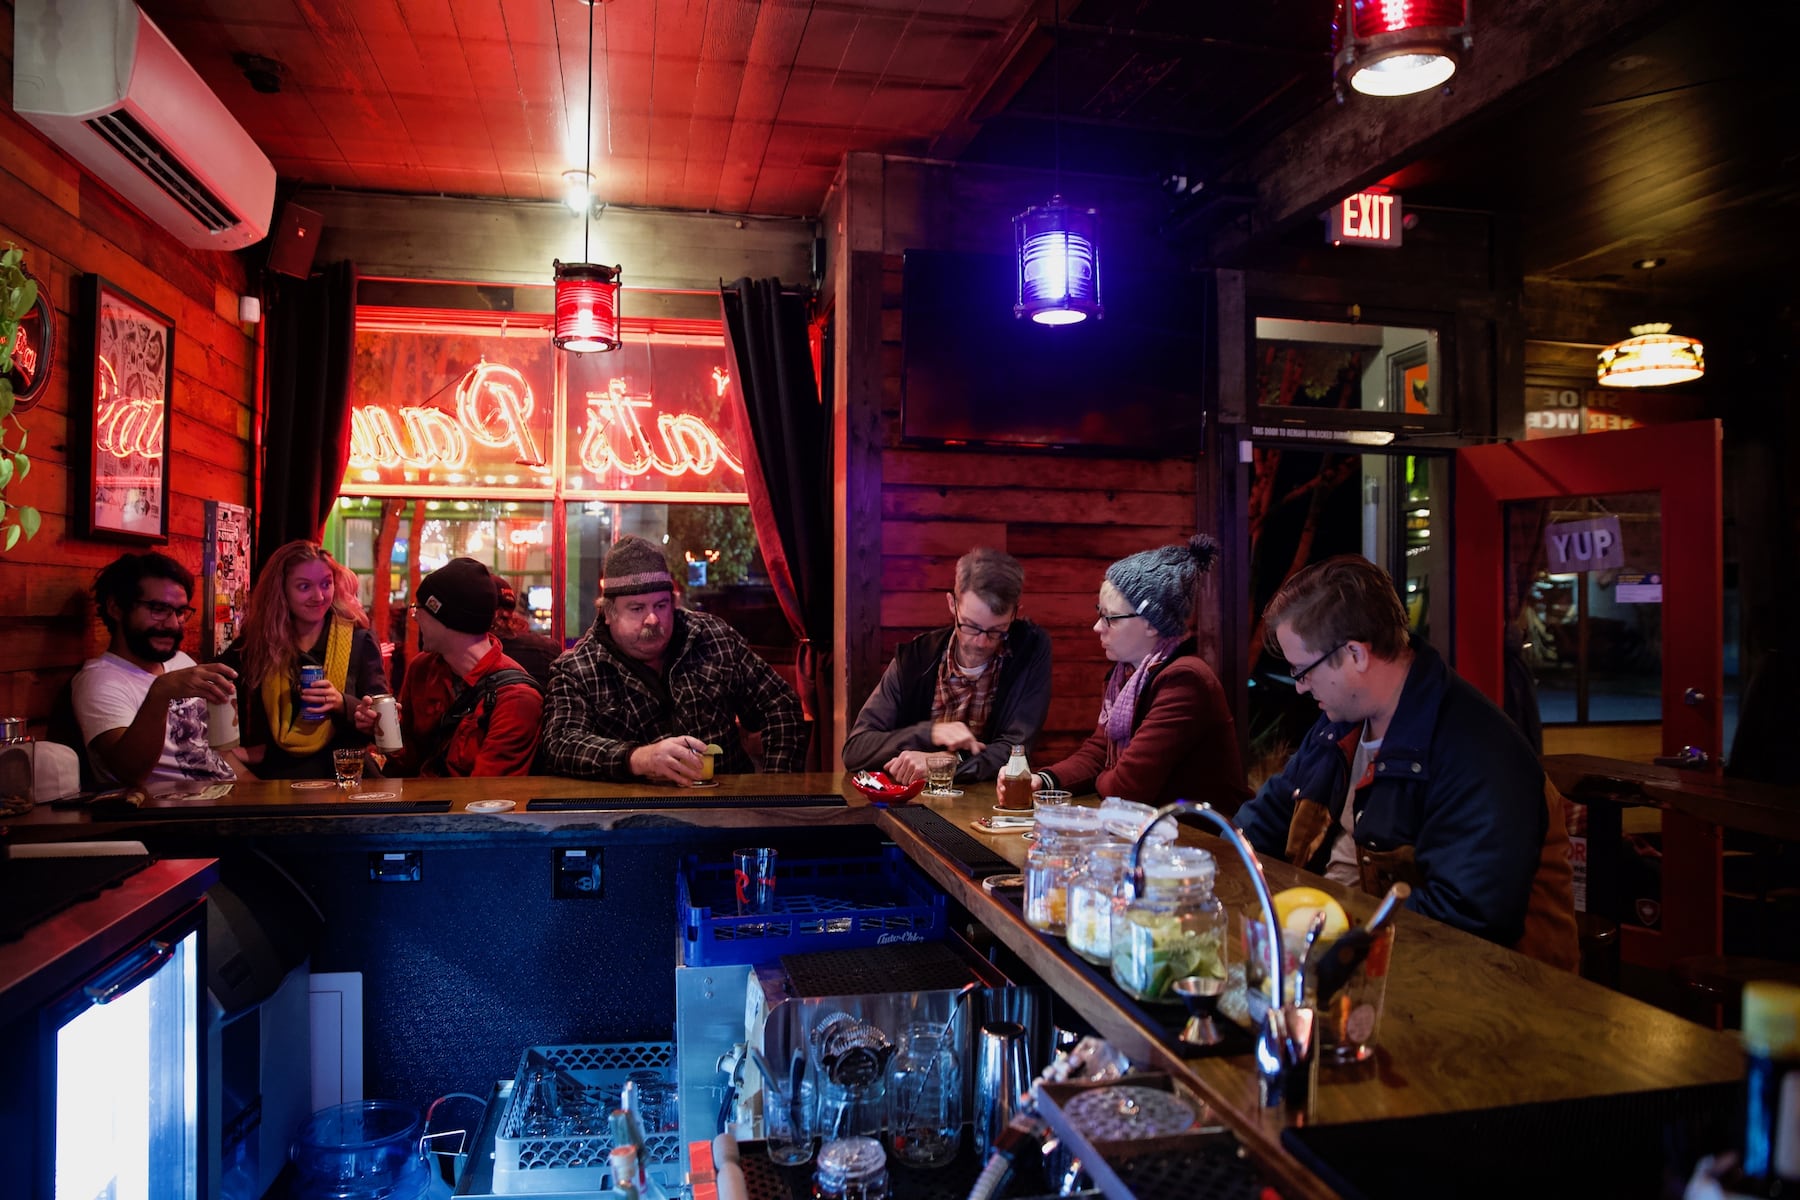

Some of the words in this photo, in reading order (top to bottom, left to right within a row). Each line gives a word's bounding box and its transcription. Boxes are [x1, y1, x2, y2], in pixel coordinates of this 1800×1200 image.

[1343, 193, 1393, 240] EXIT
[1252, 426, 1264, 436] THIS
[1264, 427, 1279, 437] DOOR
[1279, 428, 1286, 437] TO
[1551, 529, 1613, 563] YUP
